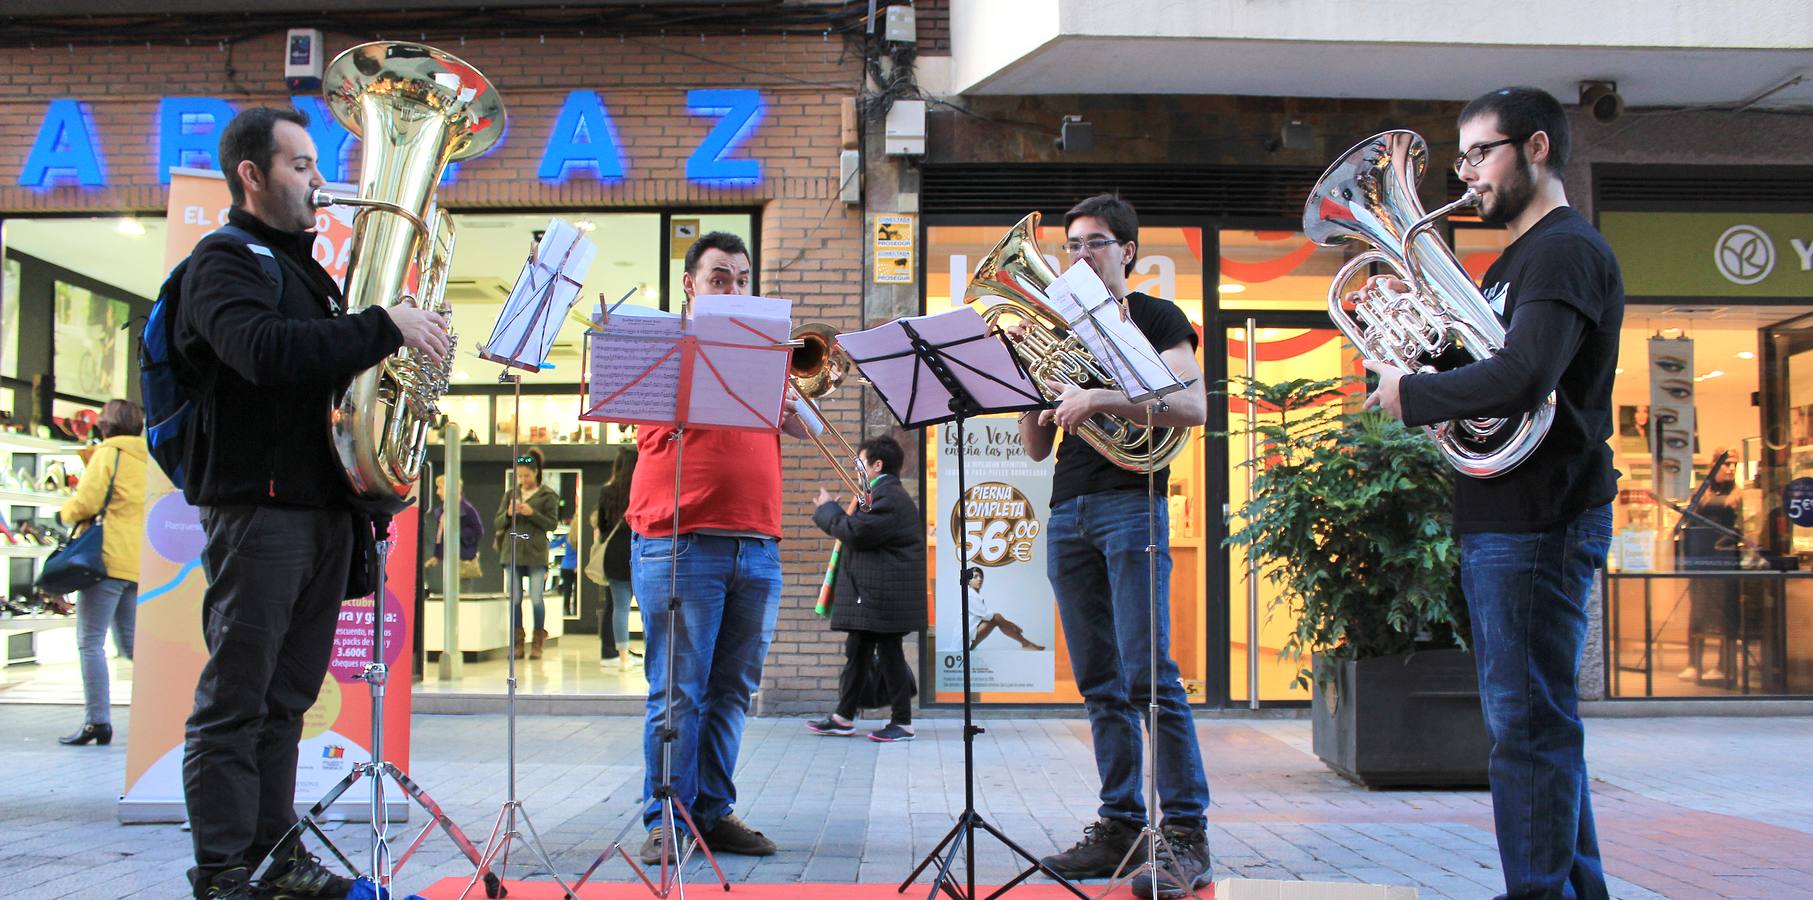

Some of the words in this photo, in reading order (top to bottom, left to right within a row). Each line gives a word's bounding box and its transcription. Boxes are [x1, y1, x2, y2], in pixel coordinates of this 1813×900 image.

[184, 206, 210, 225] EL
[945, 425, 979, 446] Ese
[985, 445, 1001, 456] las
[973, 486, 1012, 500] PIERNA
[356, 613, 363, 624] y
[343, 638, 358, 646] packs
[337, 648, 367, 657] 3.600€
[332, 659, 359, 668] cheques
